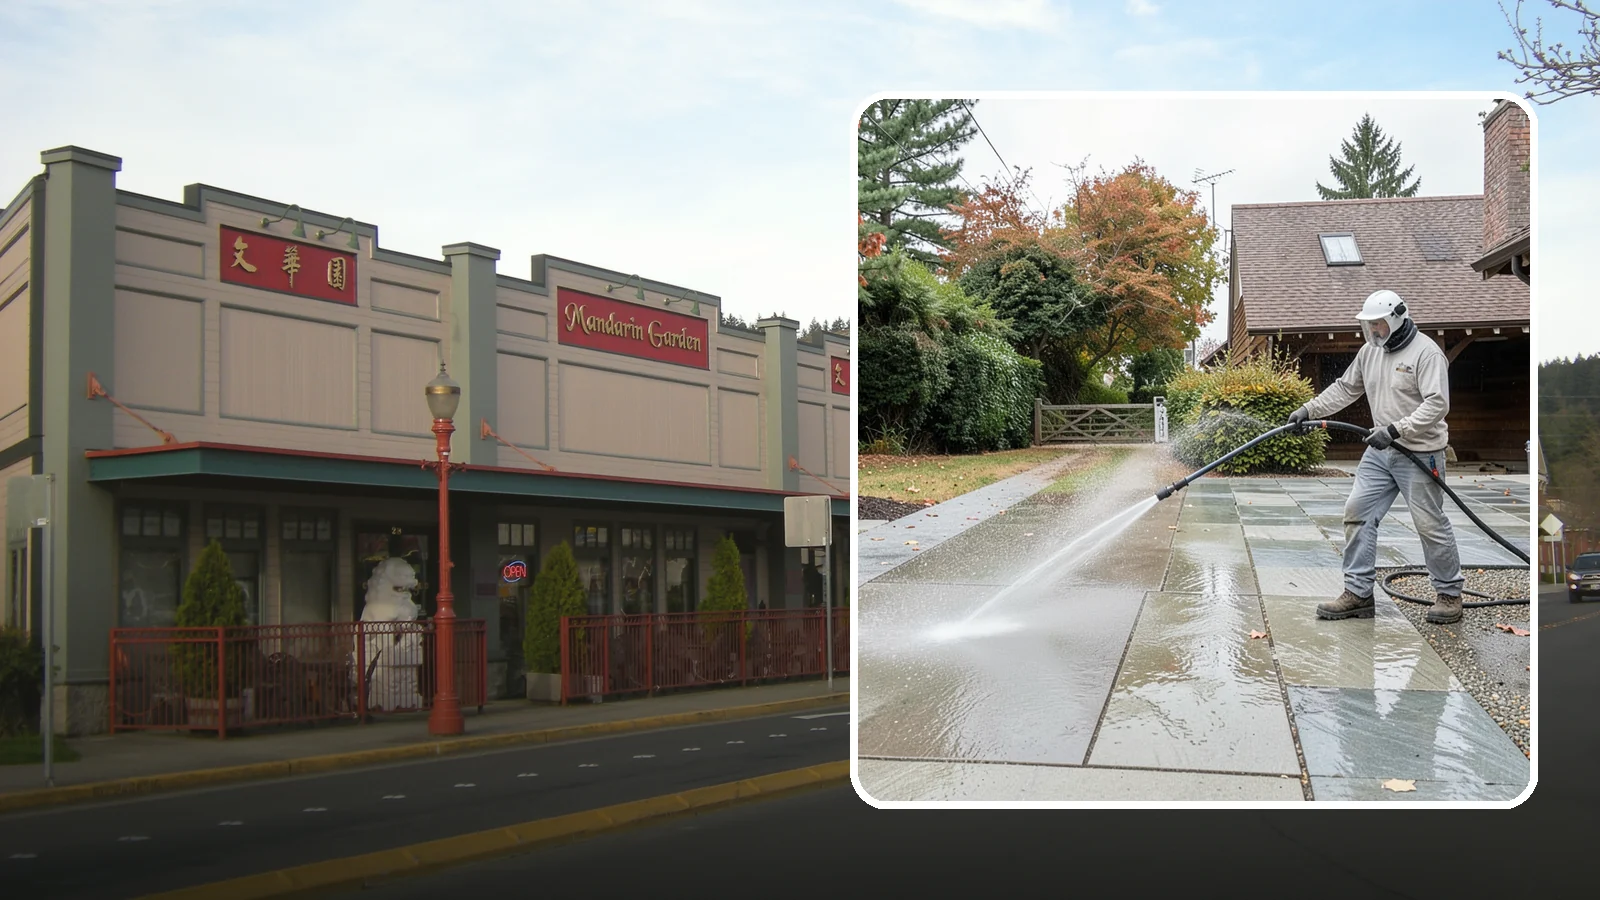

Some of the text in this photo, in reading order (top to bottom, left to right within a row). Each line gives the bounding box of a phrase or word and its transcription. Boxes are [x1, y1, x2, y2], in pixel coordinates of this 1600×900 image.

[231, 236, 346, 290] 文華園
[564, 302, 701, 352] Mandarin Garden
[835, 363, 846, 386] 文
[503, 565, 527, 578] OPEN
